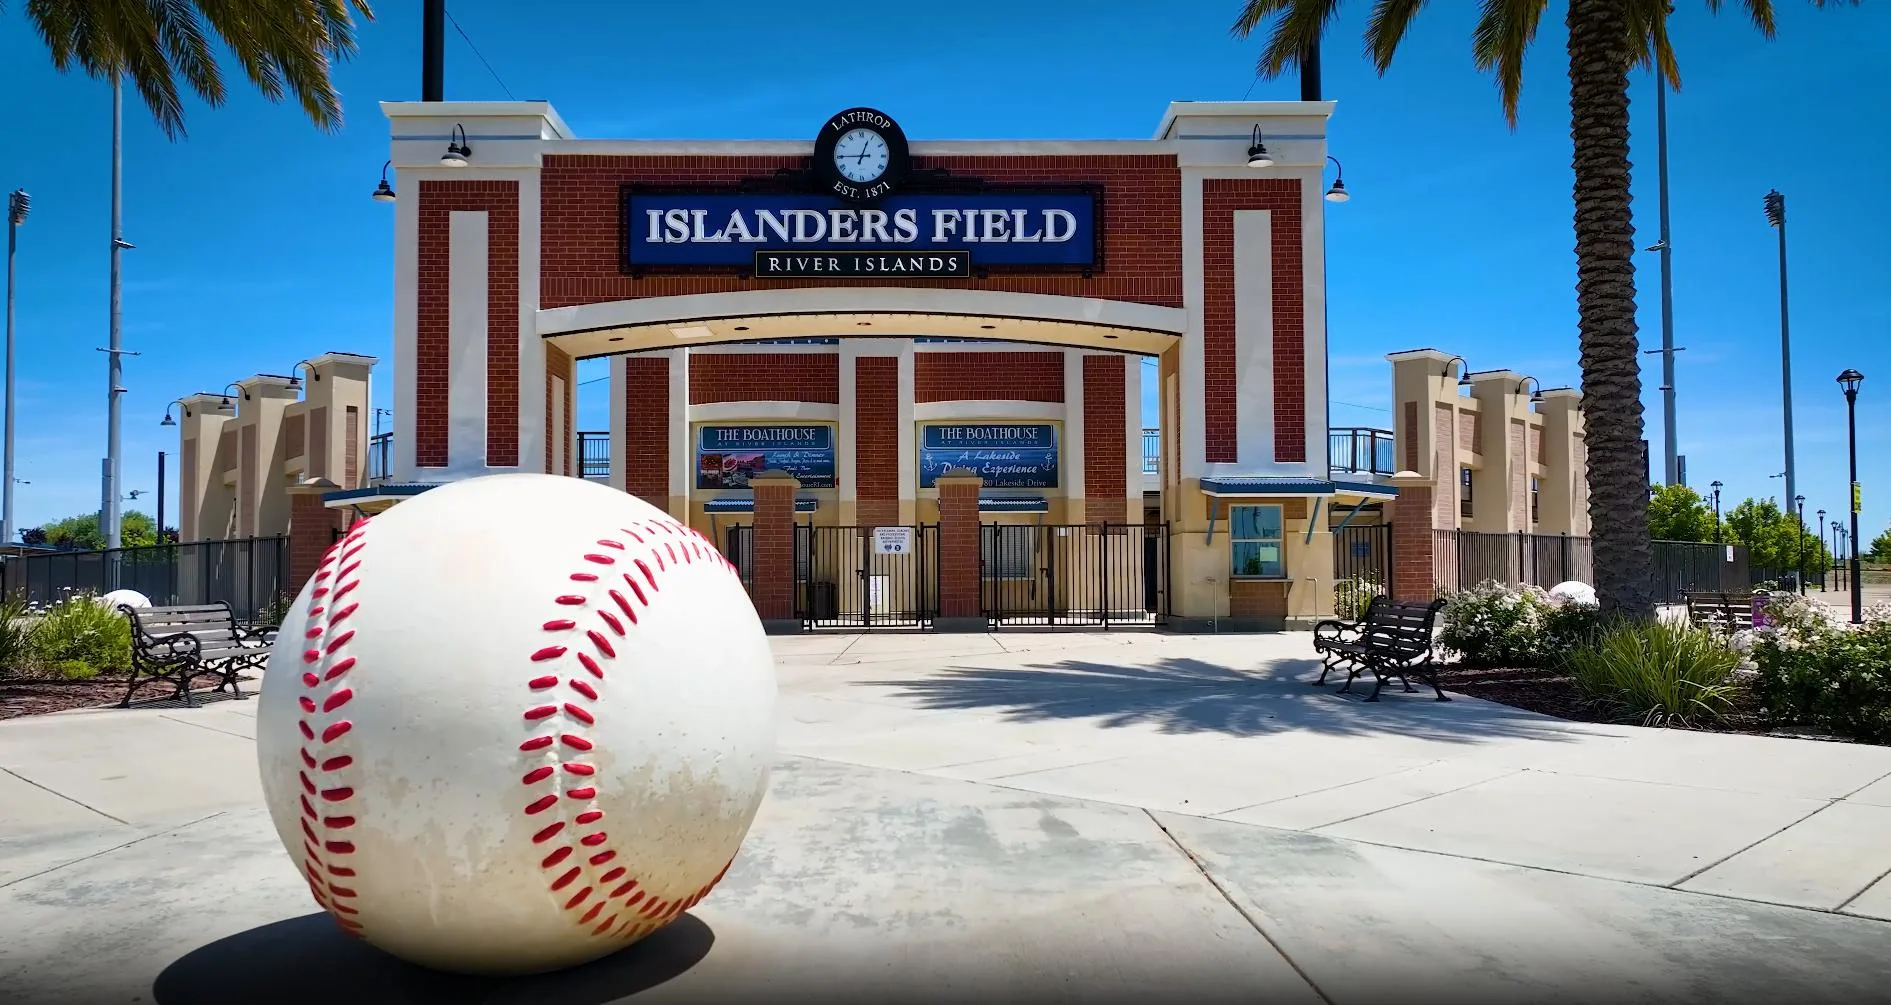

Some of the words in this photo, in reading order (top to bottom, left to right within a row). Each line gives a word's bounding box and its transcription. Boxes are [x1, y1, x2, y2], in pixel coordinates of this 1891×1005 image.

[832, 111, 891, 131] LATHROP
[833, 181, 860, 199] EST.
[865, 181, 891, 198] 1871
[645, 208, 919, 243] ISLANDERS
[931, 208, 1077, 243] FIELD
[768, 257, 841, 271] RIVER
[854, 257, 958, 271] ISLANDS
[716, 428, 740, 441] THE
[743, 428, 816, 441] BOATHOUSE
[939, 427, 963, 440] THE
[966, 427, 1039, 440] BOATHOUSE
[957, 451, 969, 463] A
[973, 450, 1021, 461] Lakeside
[981, 461, 1038, 478] Experience
[995, 479, 1025, 487] Lakeside
[1027, 479, 1047, 487] Drive
